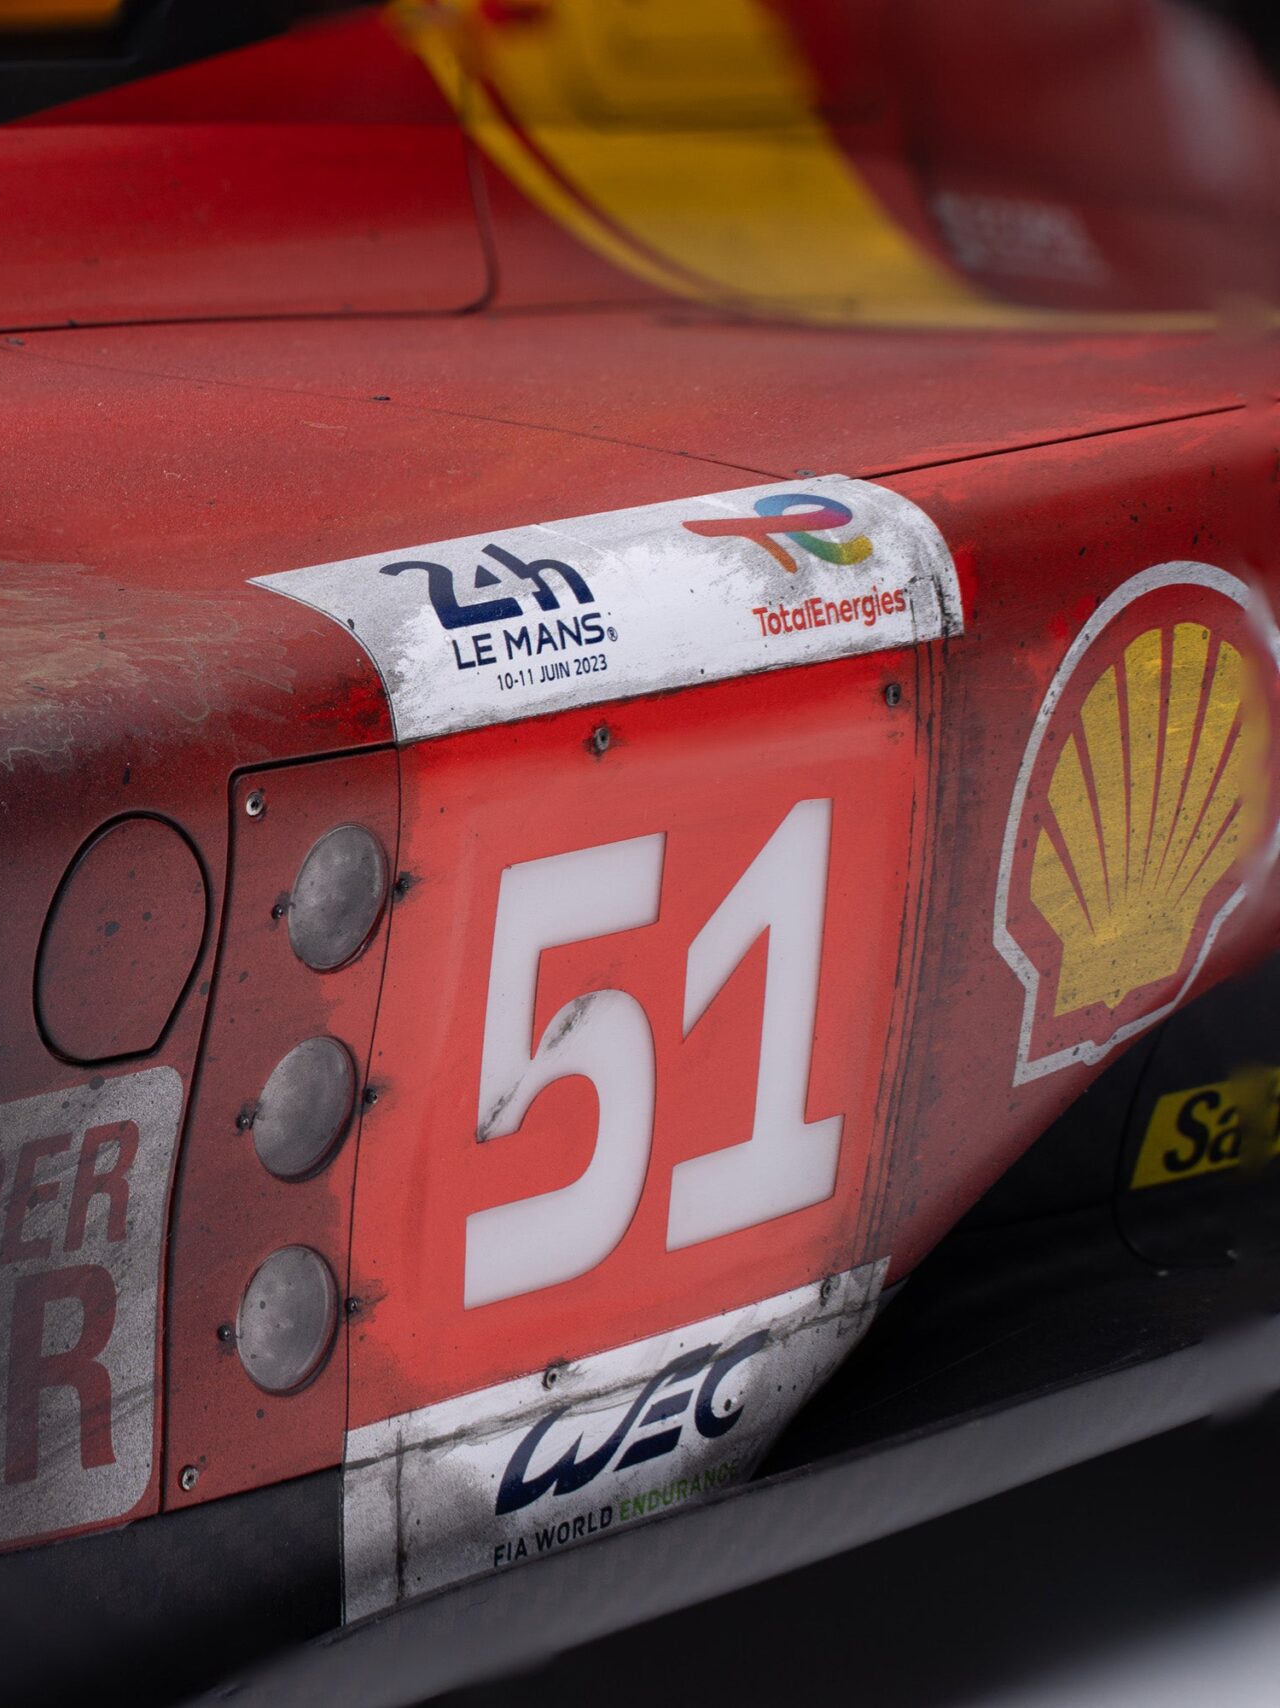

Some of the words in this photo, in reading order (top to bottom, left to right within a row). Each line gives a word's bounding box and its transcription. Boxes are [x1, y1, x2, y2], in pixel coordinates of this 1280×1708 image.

[379, 543, 596, 630] 24h
[752, 584, 907, 637] TotalEnergies
[452, 632, 497, 670] LE
[497, 668, 534, 691] 10-11
[539, 660, 571, 683] JUIN
[573, 653, 608, 676] 2023
[463, 797, 846, 1312] 51
[1163, 1082, 1280, 1172] Sa
[495, 1328, 770, 1516] WEC
[494, 1537, 528, 1567] FIA
[535, 1505, 613, 1551] WORLD
